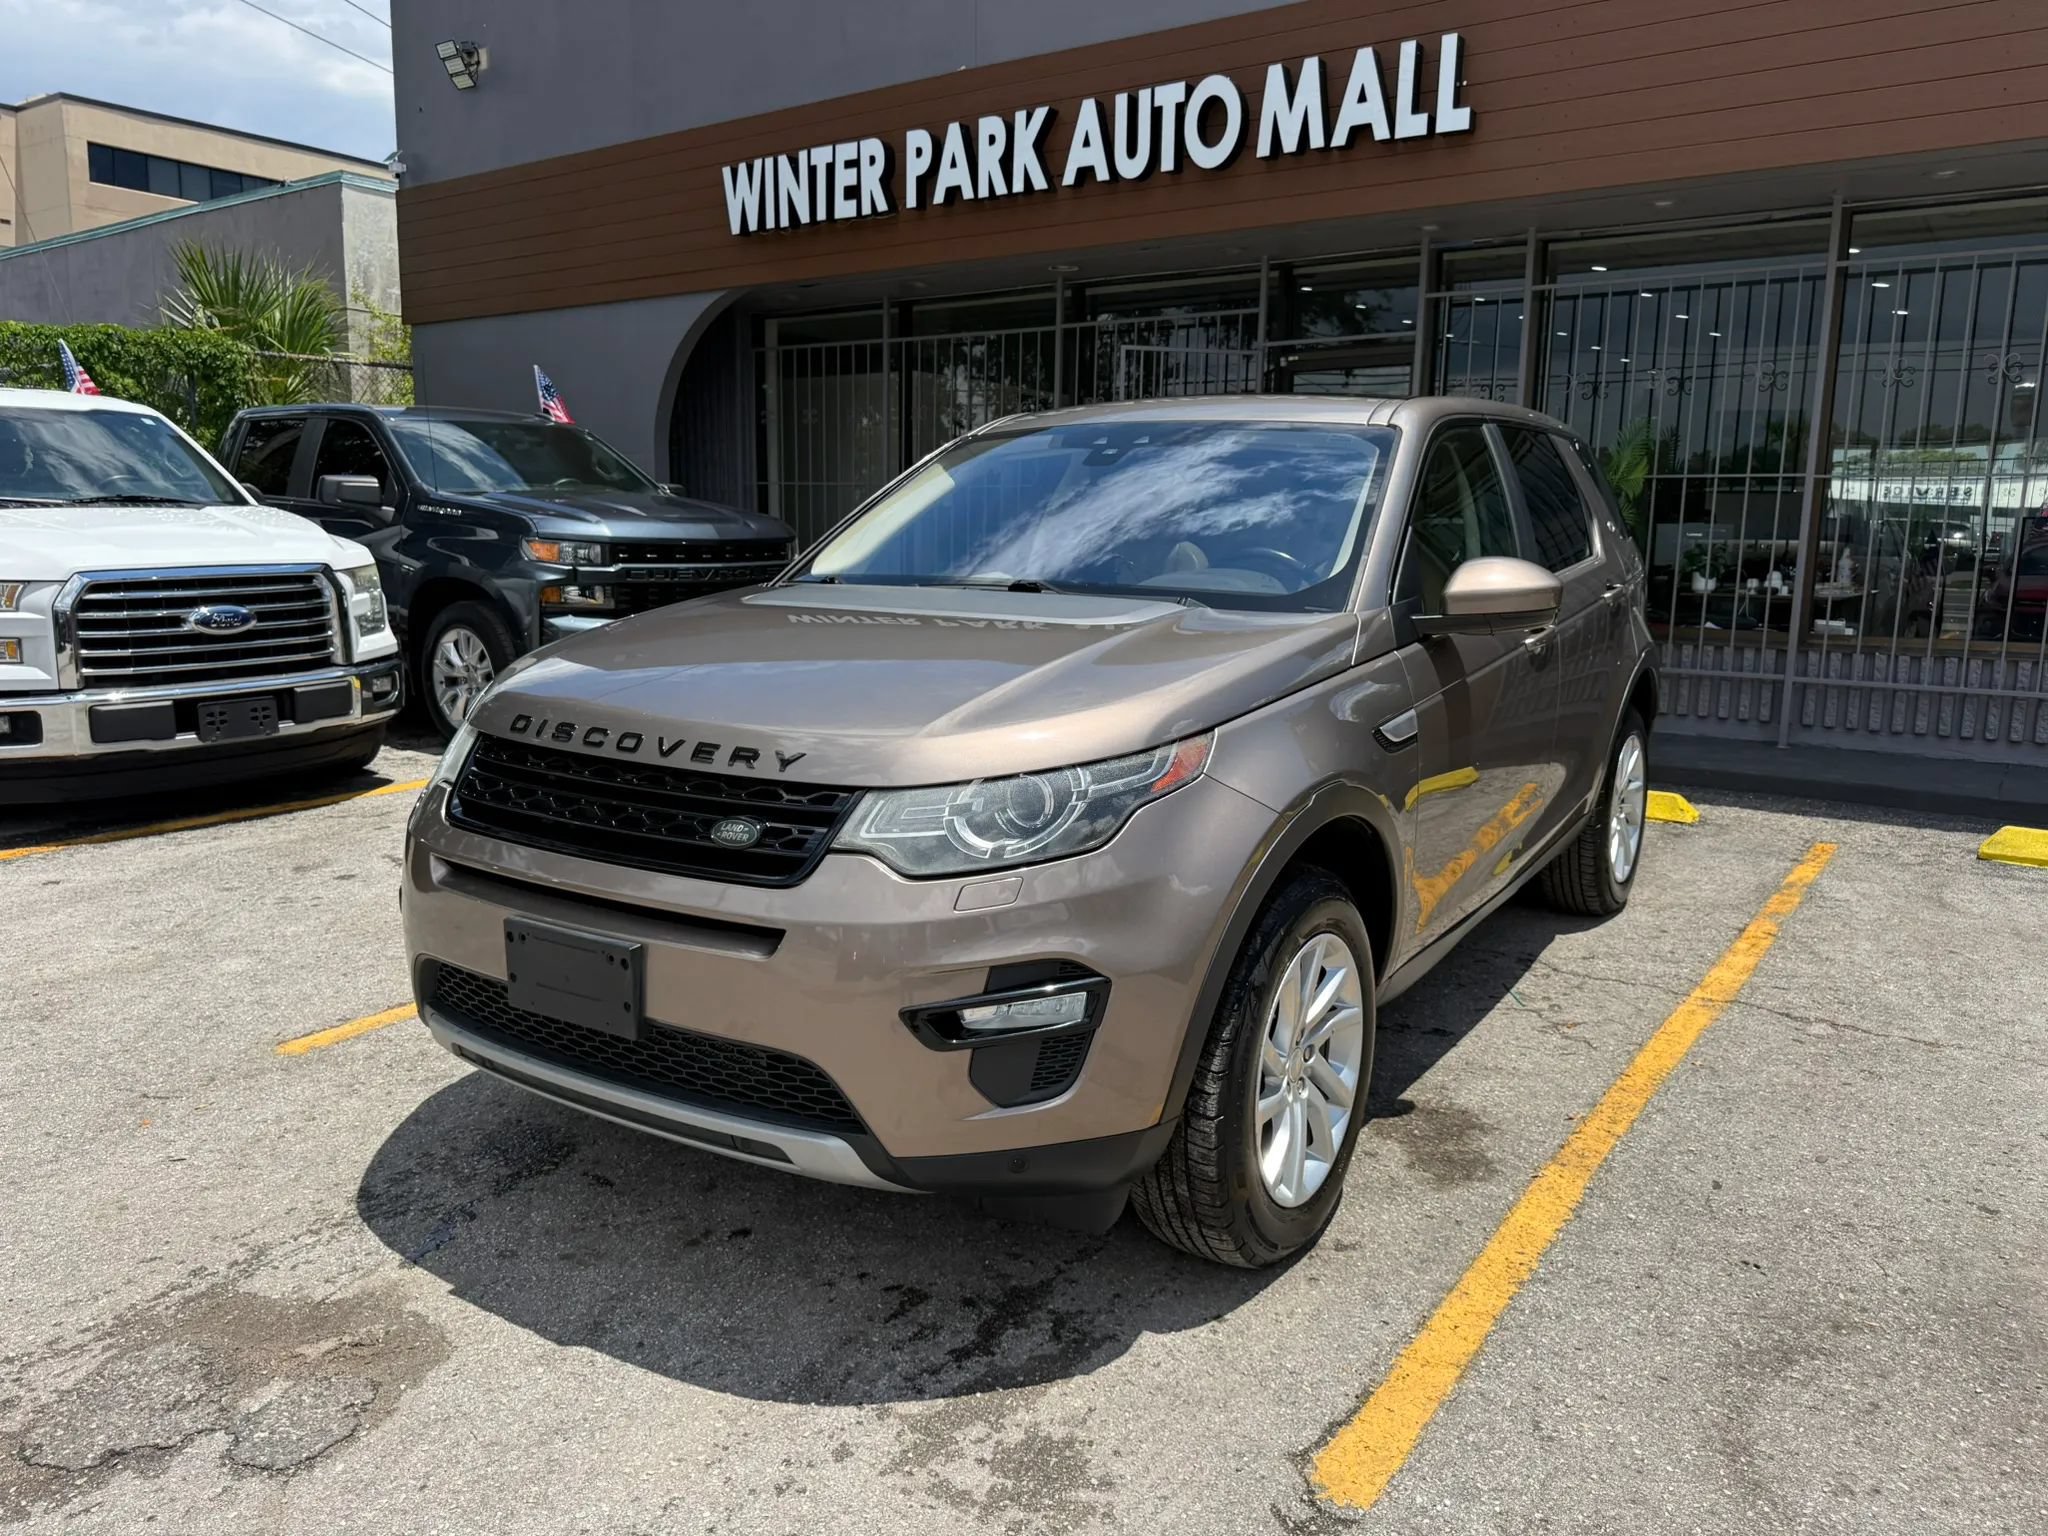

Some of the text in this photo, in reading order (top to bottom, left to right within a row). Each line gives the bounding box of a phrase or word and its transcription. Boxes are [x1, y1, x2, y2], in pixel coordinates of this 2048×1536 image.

[722, 32, 1472, 236] WINTER PARK AUTO MALL
[510, 713, 807, 773] DISCOVERY
